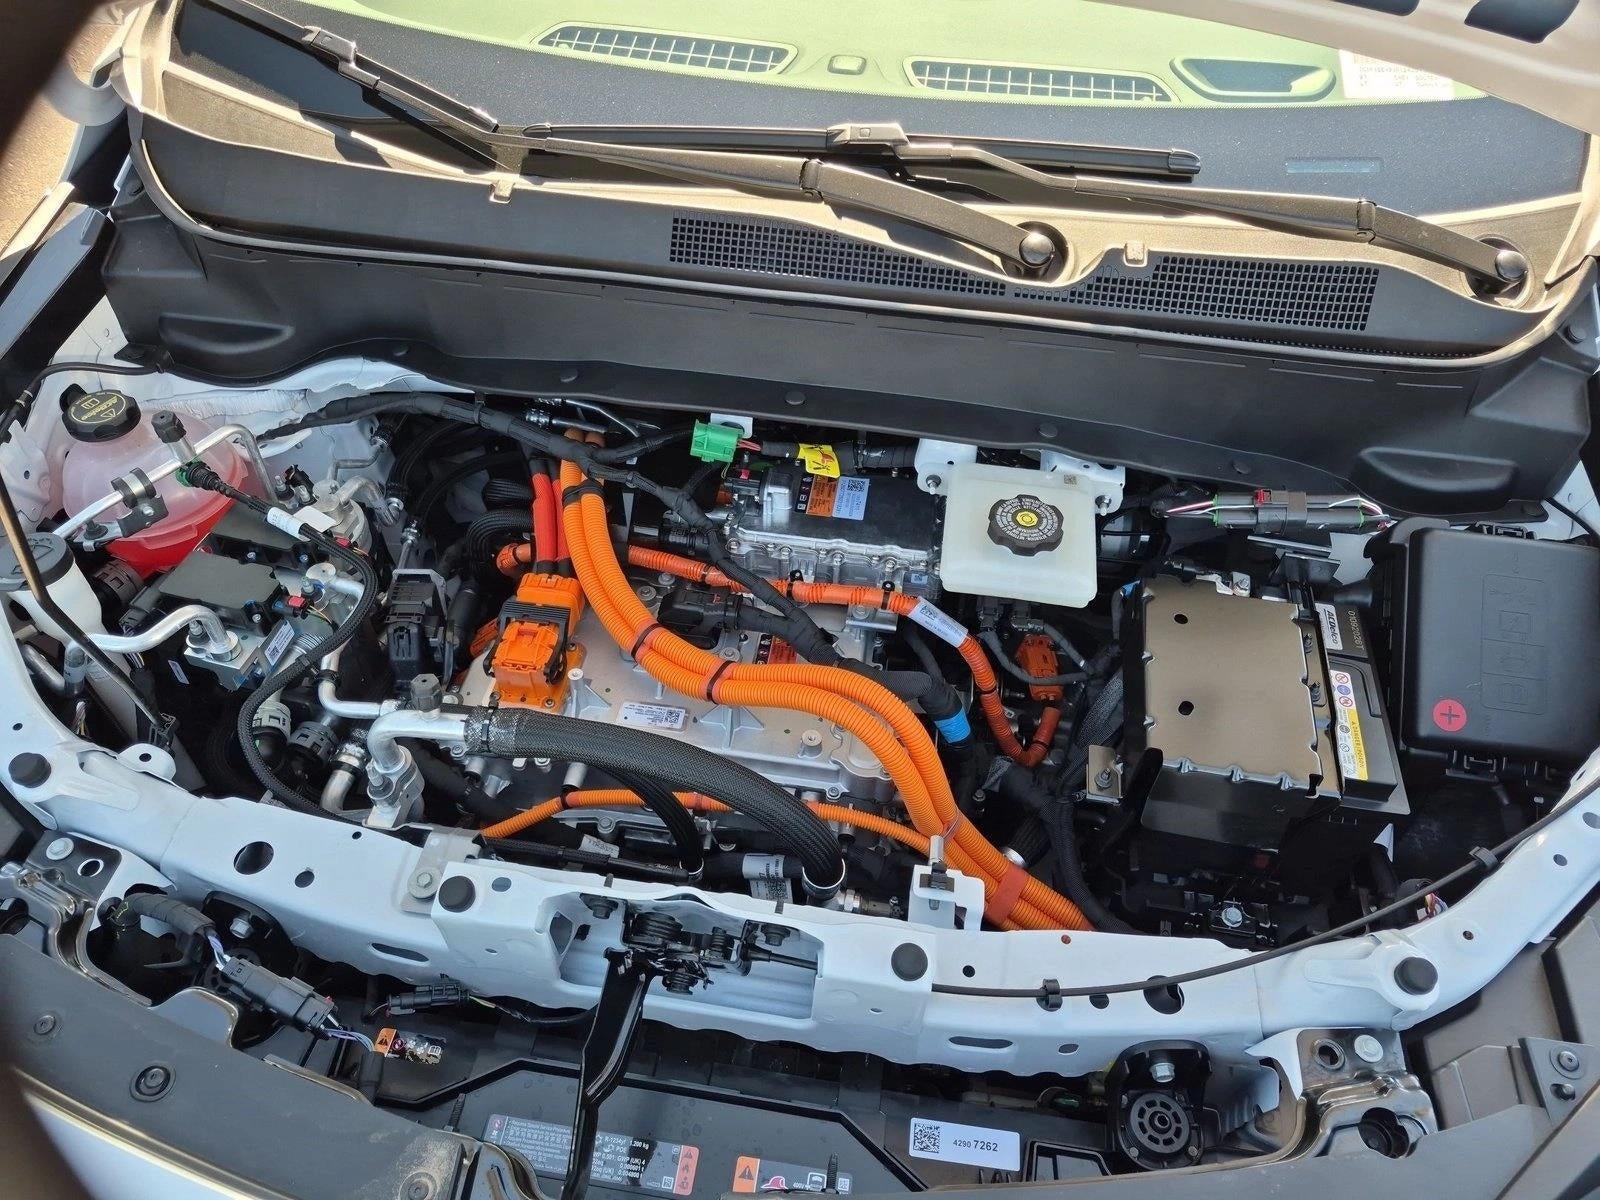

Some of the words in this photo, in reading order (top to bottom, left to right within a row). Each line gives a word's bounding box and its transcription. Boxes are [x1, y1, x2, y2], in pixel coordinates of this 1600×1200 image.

[1326, 610, 1339, 645] ACDelco
[953, 1139, 971, 1148] 4290
[973, 1140, 998, 1152] 7262
